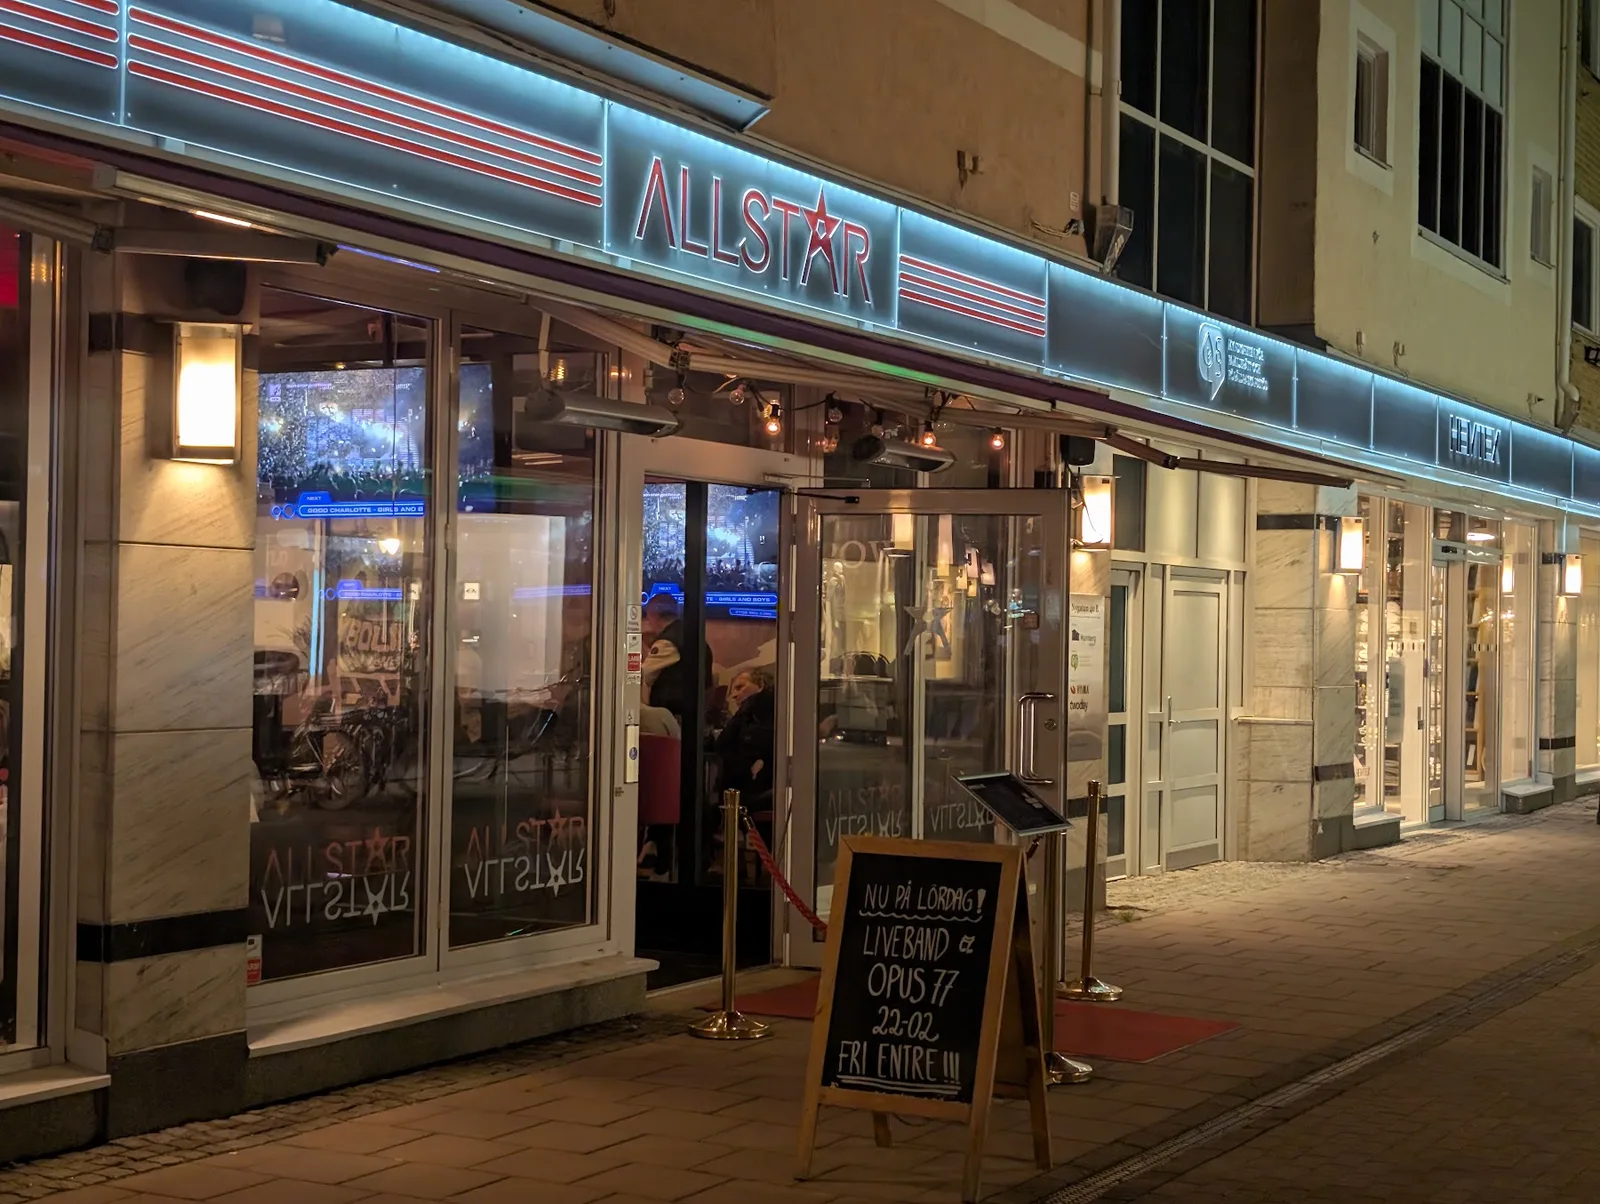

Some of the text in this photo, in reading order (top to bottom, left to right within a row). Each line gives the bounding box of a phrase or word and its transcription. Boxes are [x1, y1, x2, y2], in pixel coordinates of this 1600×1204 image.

[635, 155, 873, 305] ALLSTAR
[377, 506, 399, 514] GIRLS
[864, 880, 987, 914] NU PÅ LÖRDAG!
[863, 925, 949, 961] LIVEBAND
[868, 963, 960, 1007] OPUS 77
[872, 1005, 940, 1042] 22-02
[838, 1040, 867, 1075] FRI
[877, 1043, 938, 1081] ENTRE
